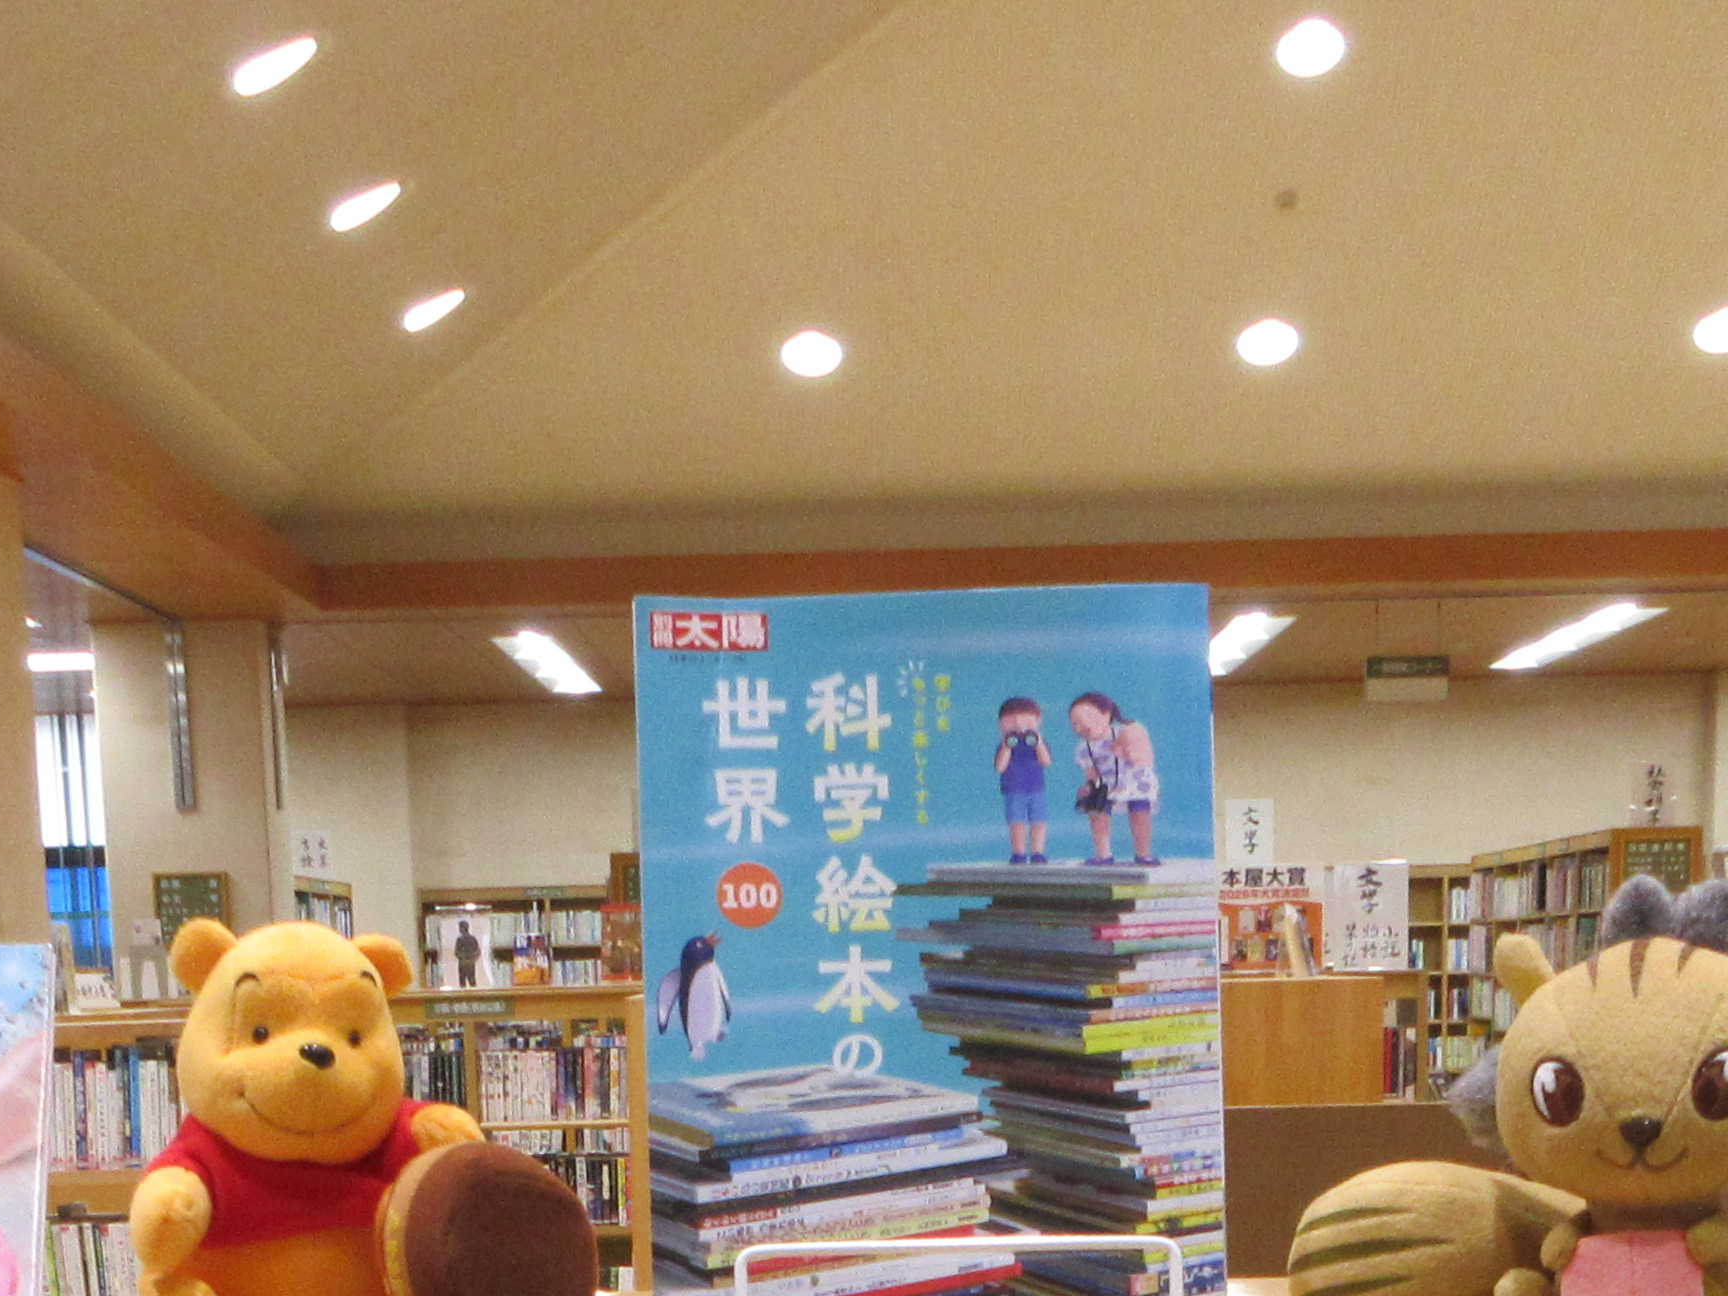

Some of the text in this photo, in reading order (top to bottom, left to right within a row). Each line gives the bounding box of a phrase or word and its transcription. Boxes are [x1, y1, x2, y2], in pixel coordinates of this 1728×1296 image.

[674, 613, 767, 650] 太陽
[701, 676, 791, 844] 世界
[805, 671, 901, 1078] 科学絵本の
[1222, 866, 1307, 888] 本屋大賞
[720, 881, 779, 910] 100
